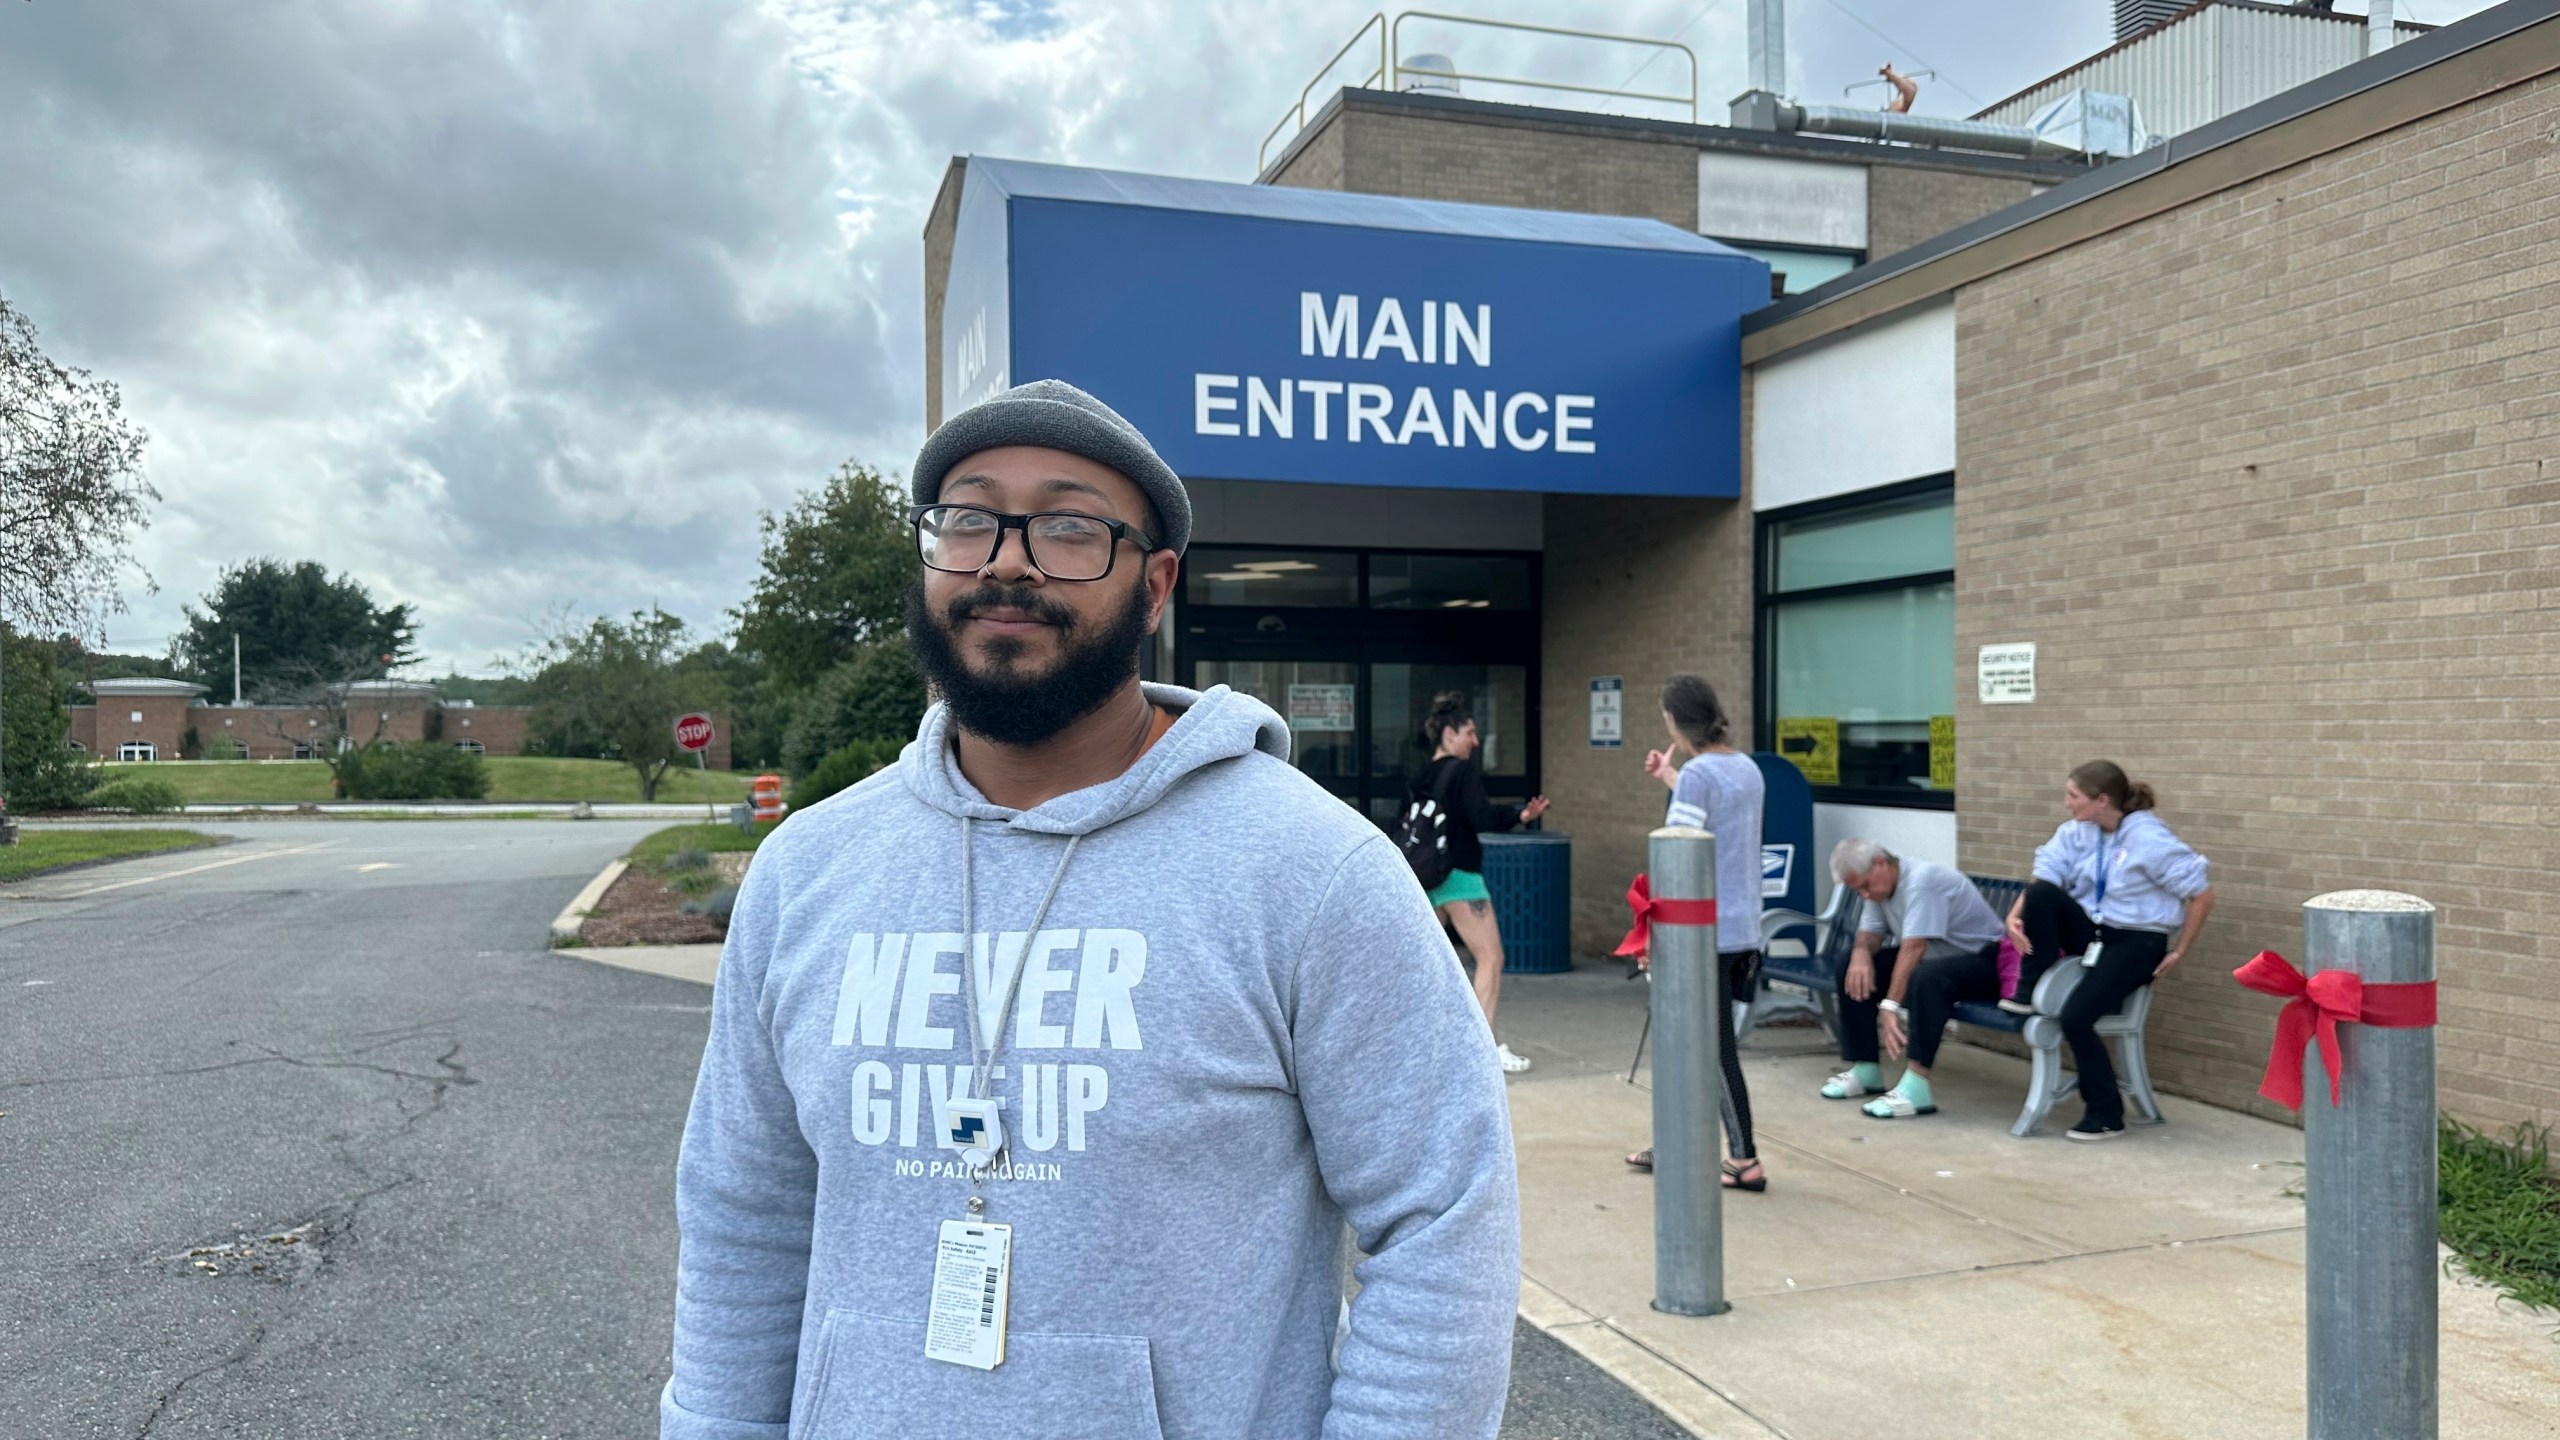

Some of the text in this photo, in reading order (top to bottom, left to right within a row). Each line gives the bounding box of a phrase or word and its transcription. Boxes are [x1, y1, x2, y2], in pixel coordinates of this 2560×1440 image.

[1299, 291, 1492, 368] MAIN
[1194, 373, 1597, 455] ENTRANCE
[678, 722, 711, 743] STOP
[832, 928, 1148, 1051] NEVER
[1022, 1063, 1109, 1152] UP
[895, 1158, 925, 1177] NO
[1013, 1162, 1062, 1181] GAIN
